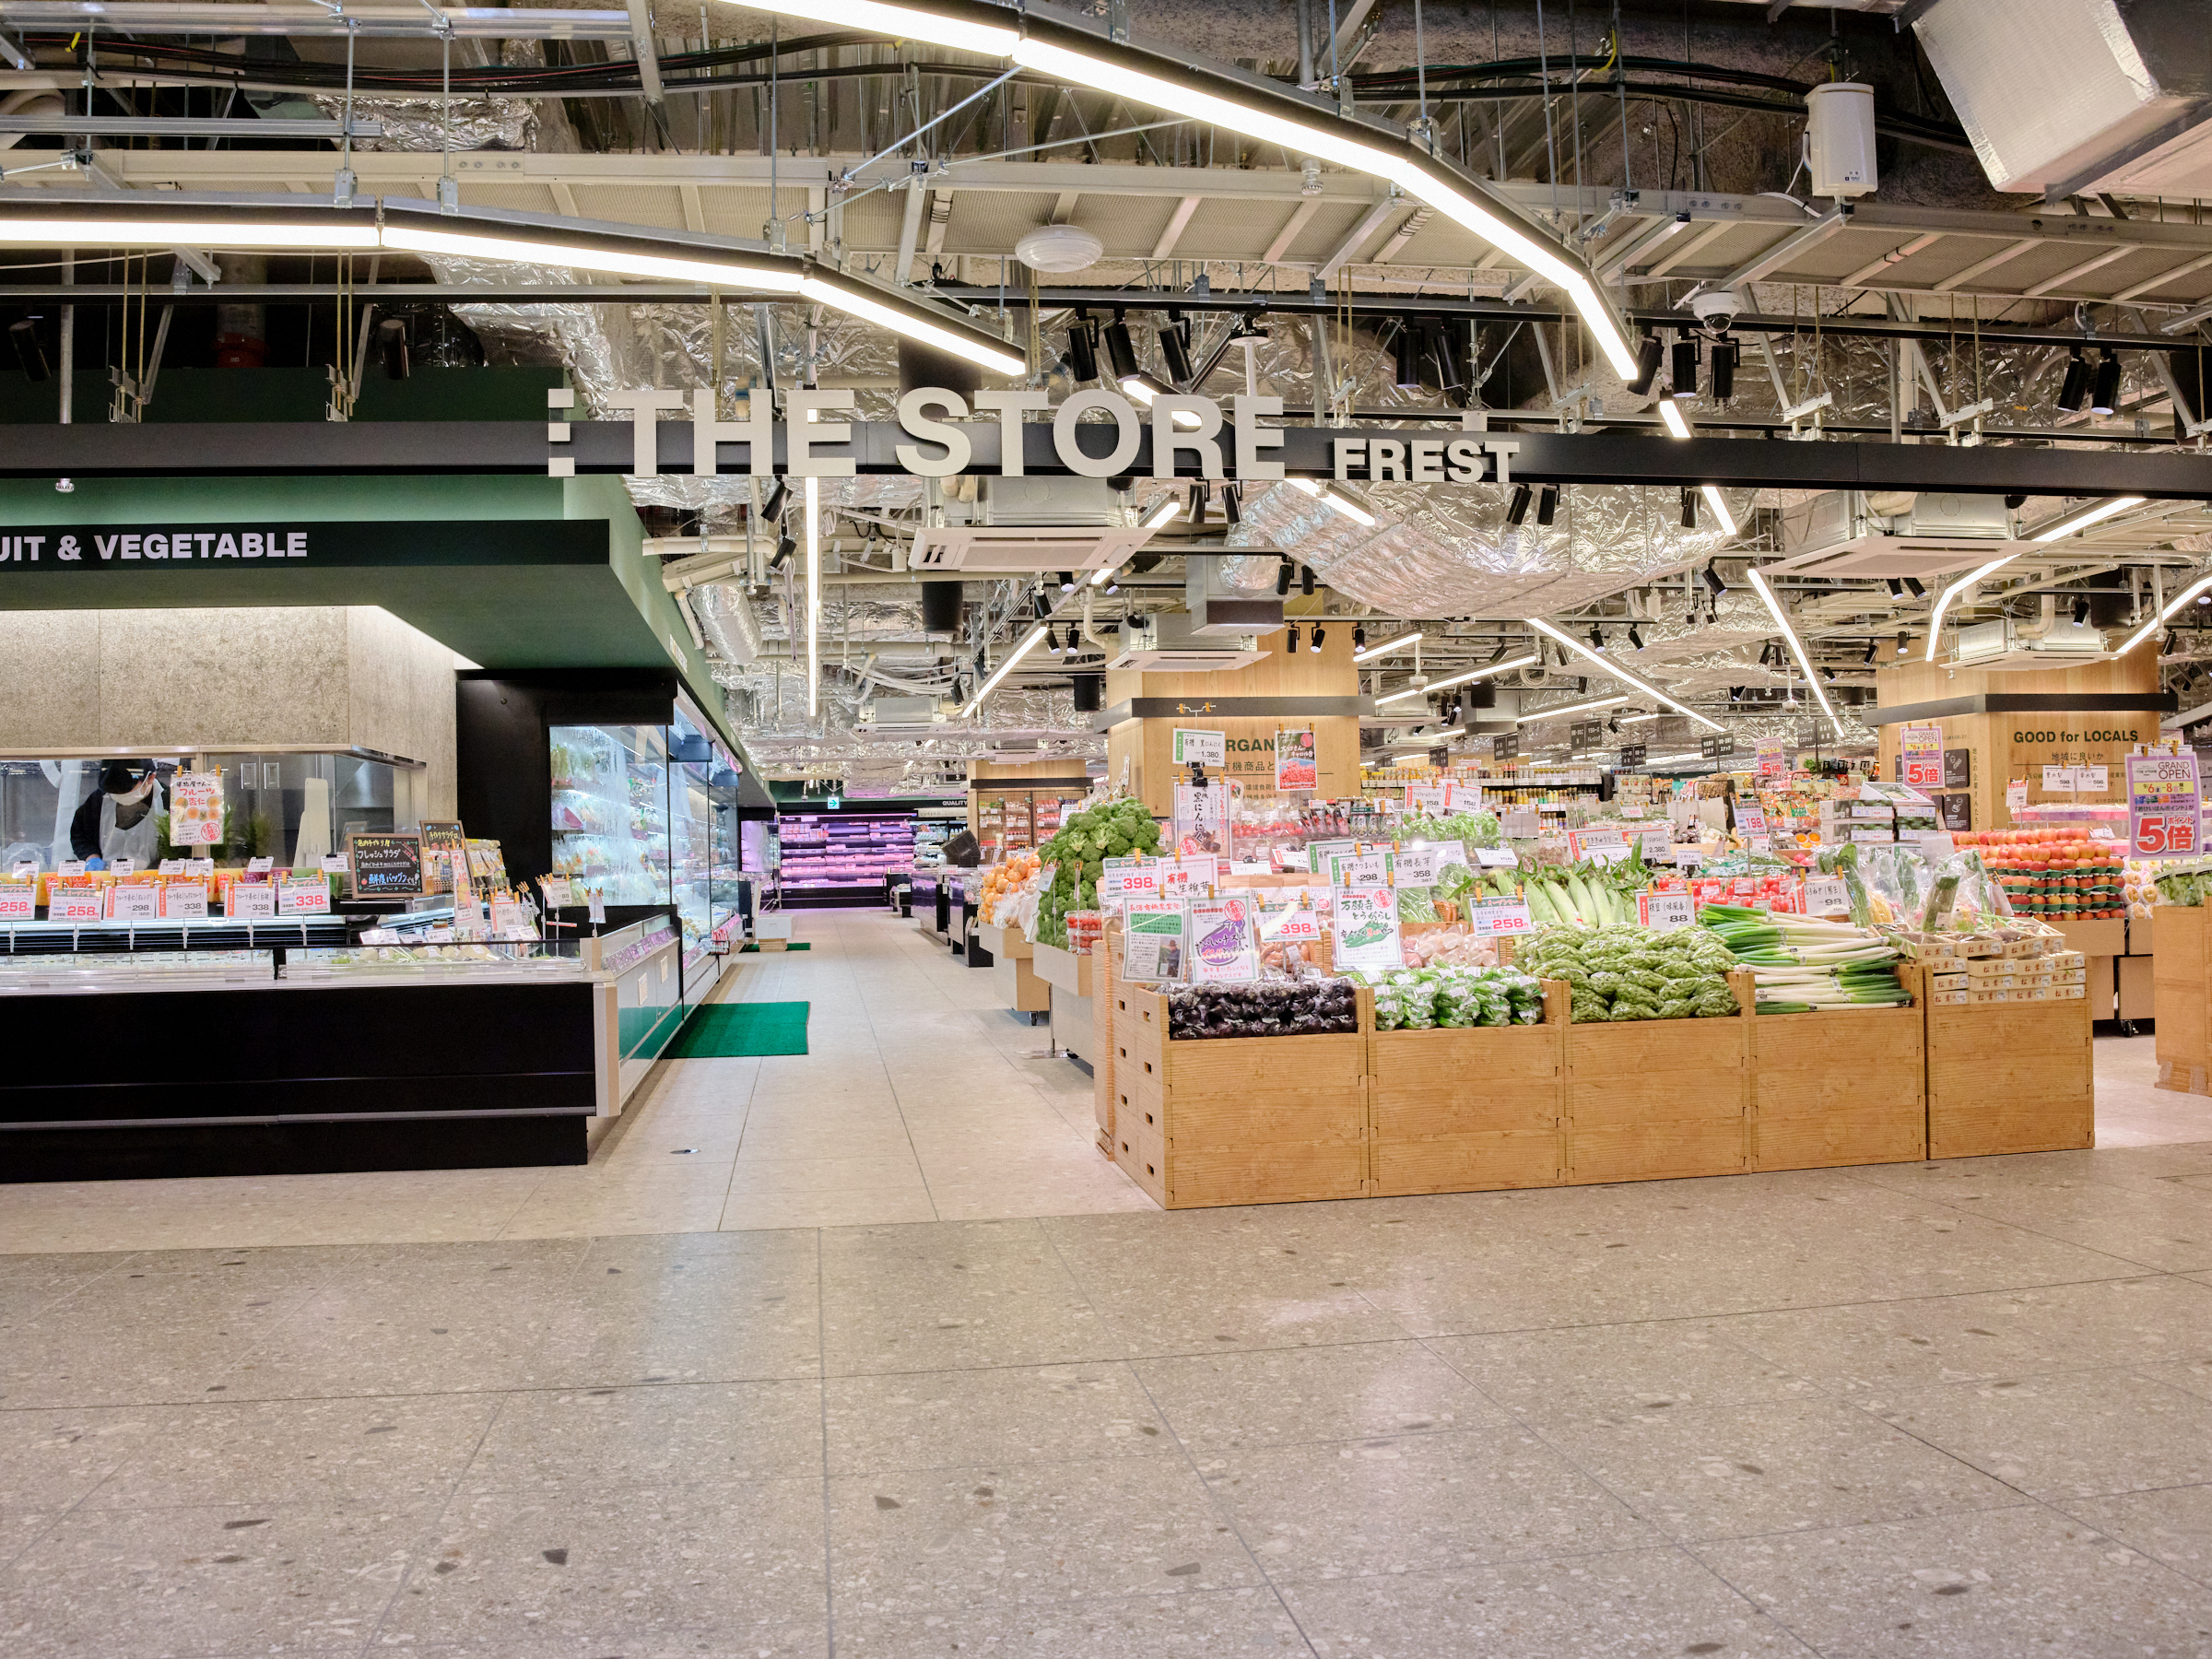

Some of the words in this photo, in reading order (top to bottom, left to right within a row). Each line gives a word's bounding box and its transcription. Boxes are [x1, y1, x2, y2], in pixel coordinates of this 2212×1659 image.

[607, 388, 856, 477] THE
[895, 386, 1285, 480] STORE
[1334, 438, 1520, 482] FREST
[57, 535, 82, 560] &
[94, 532, 308, 560] VEGETABLE
[2014, 731, 2056, 743] GOOD
[2061, 731, 2080, 743] for
[2084, 730, 2138, 742] LOCALS
[1225, 738, 1275, 752] RGAN
[2159, 761, 2190, 770] GRAND
[2159, 769, 2191, 780] OPEN
[179, 788, 216, 796] フルーツ
[188, 797, 206, 806] 杏仁
[358, 848, 401, 860] フレッシュサラダ
[1167, 872, 1188, 884] 有機
[1359, 874, 1378, 882] 298
[1413, 870, 1431, 878] 358
[1340, 899, 1373, 911] 万願寺
[1825, 898, 1842, 906] 98
[1352, 912, 1392, 920] とうがらし
[1669, 914, 1688, 923] 88
